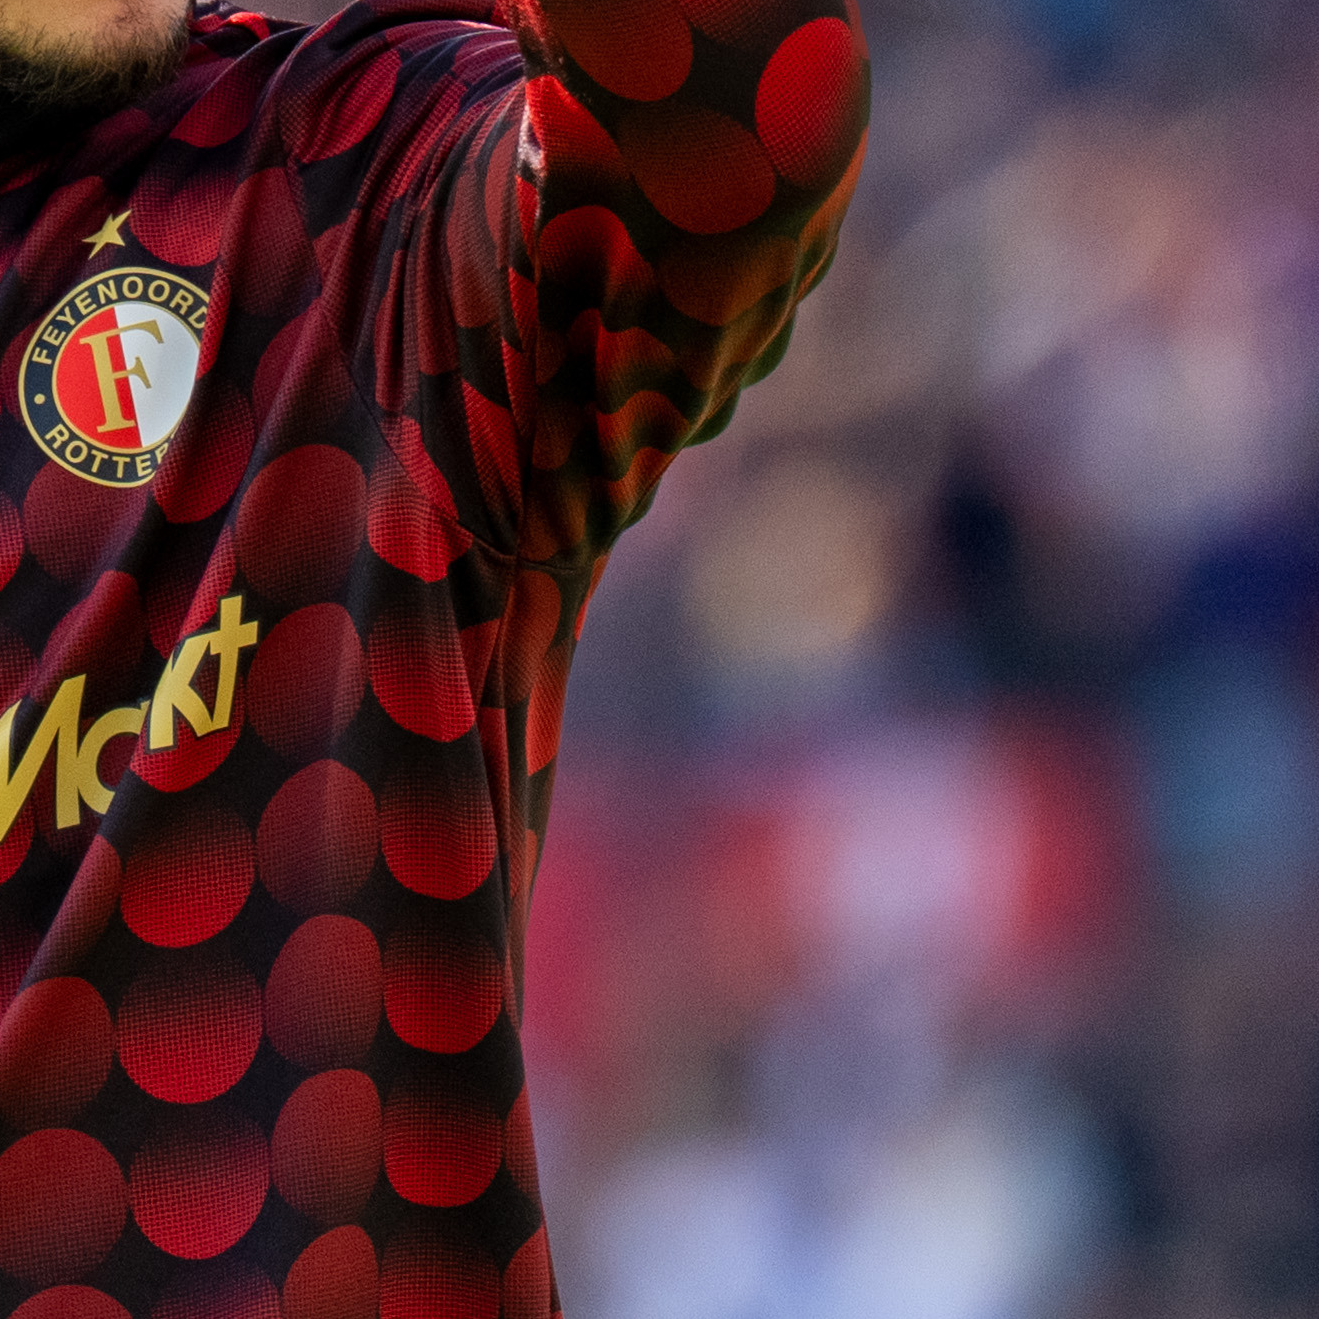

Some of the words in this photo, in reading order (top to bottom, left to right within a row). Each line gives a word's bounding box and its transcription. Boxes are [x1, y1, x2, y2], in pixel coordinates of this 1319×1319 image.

[32, 275, 208, 366] FEYENOORD
[79, 319, 165, 433] F
[44, 423, 170, 479] ROTTER
